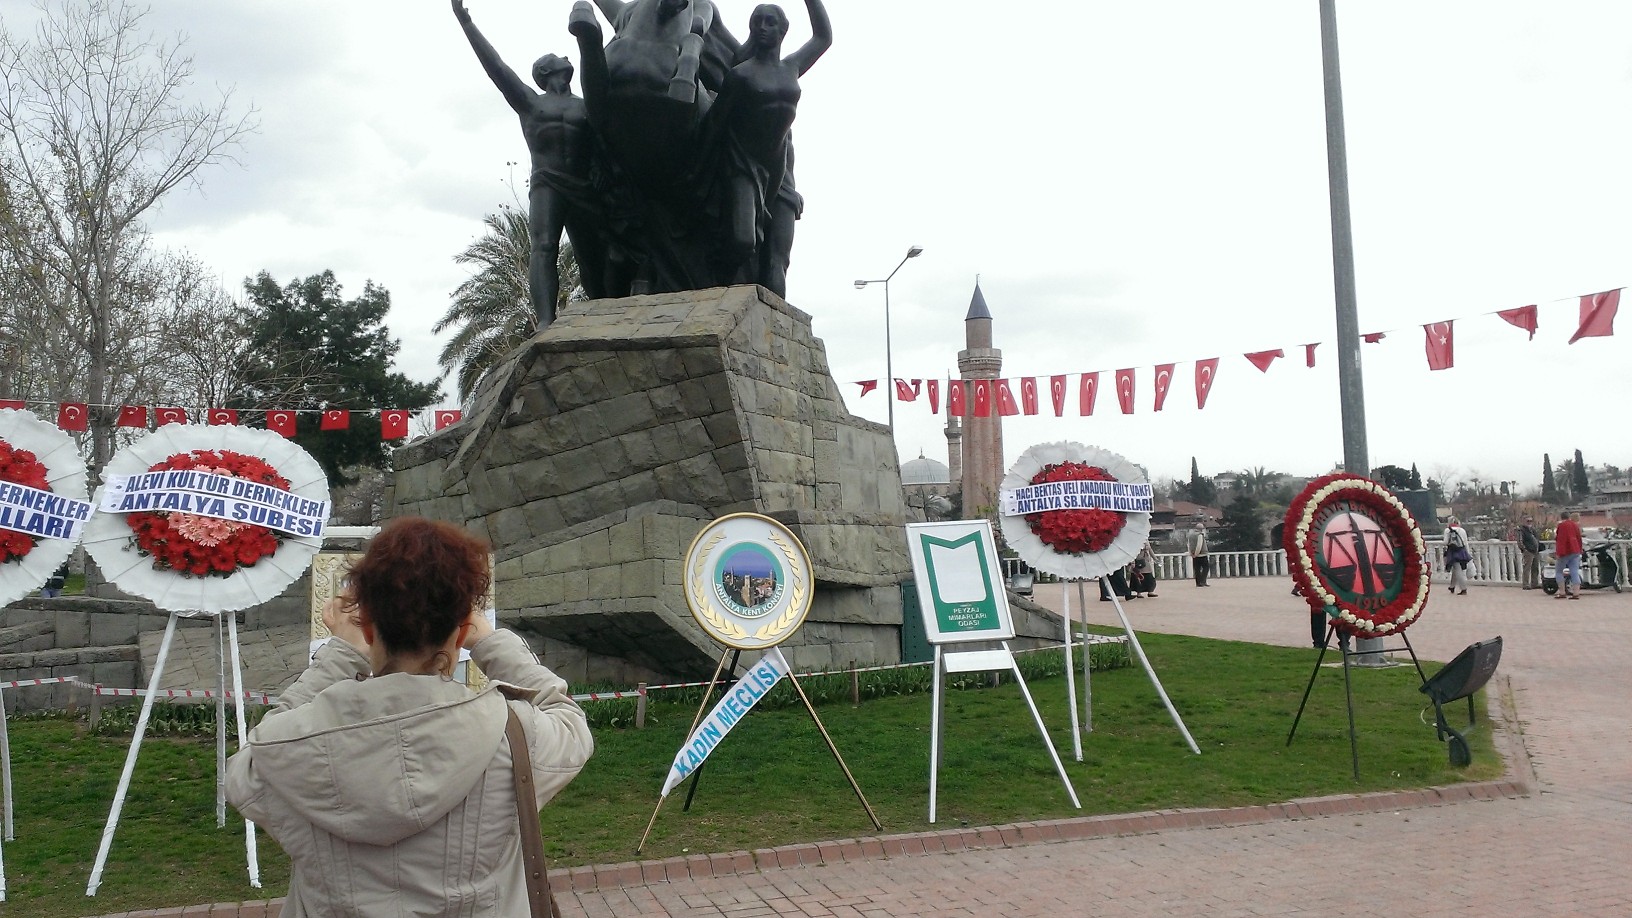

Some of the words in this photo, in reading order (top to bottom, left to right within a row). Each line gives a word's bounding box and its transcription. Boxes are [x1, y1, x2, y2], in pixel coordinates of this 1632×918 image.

[119, 493, 225, 516] ANTALYA
[166, 471, 230, 494] KÜLTÜR
[232, 480, 325, 518] DERNEKLERİ
[1016, 488, 1034, 501] HACI
[1080, 481, 1112, 496] ANADOLU
[1018, 496, 1062, 514] ANTALYA
[1113, 497, 1154, 512] KOLLARI
[715, 583, 740, 613] ANTALYA
[741, 608, 761, 616] KENT
[674, 721, 723, 779] KADIN
[715, 658, 782, 729] MECLİSİ
